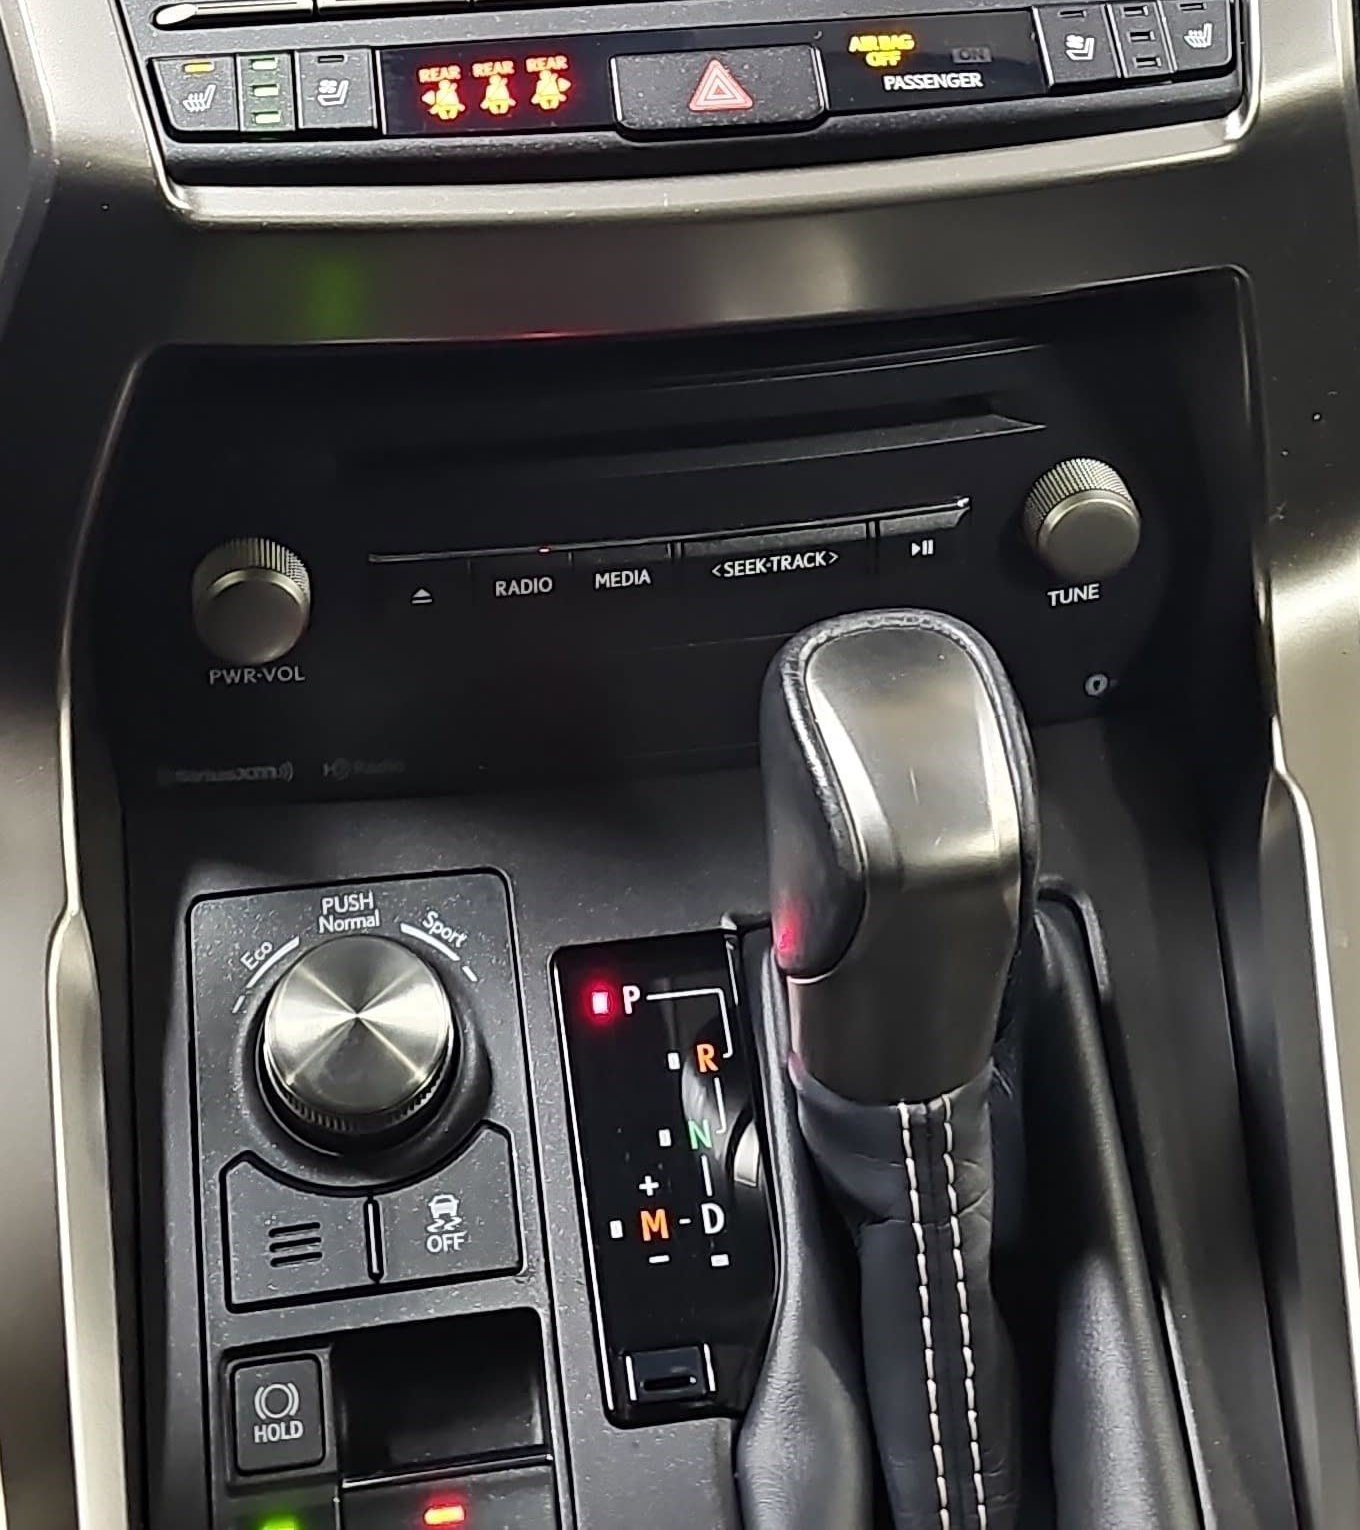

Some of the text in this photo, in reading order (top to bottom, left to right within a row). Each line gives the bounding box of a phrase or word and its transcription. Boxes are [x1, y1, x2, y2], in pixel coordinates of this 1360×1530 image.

[471, 59, 515, 78] REAR
[524, 55, 569, 73] REAR
[865, 50, 902, 67] OFF
[417, 64, 463, 84] REAR
[883, 72, 983, 91] PASSENGER
[495, 575, 553, 597] RADIO
[595, 568, 651, 590] MEDIA
[1048, 583, 1100, 607] TUNE
[321, 893, 374, 915] PUSH
[318, 910, 380, 933] Normal
[422, 910, 468, 948] Sport
[241, 942, 273, 971] Eco
[622, 985, 641, 1015] P
[696, 1043, 719, 1073] R
[688, 1118, 712, 1150] N
[640, 1202, 725, 1241] M D
[426, 1233, 466, 1253] OFF
[253, 1421, 304, 1443] HOLD
